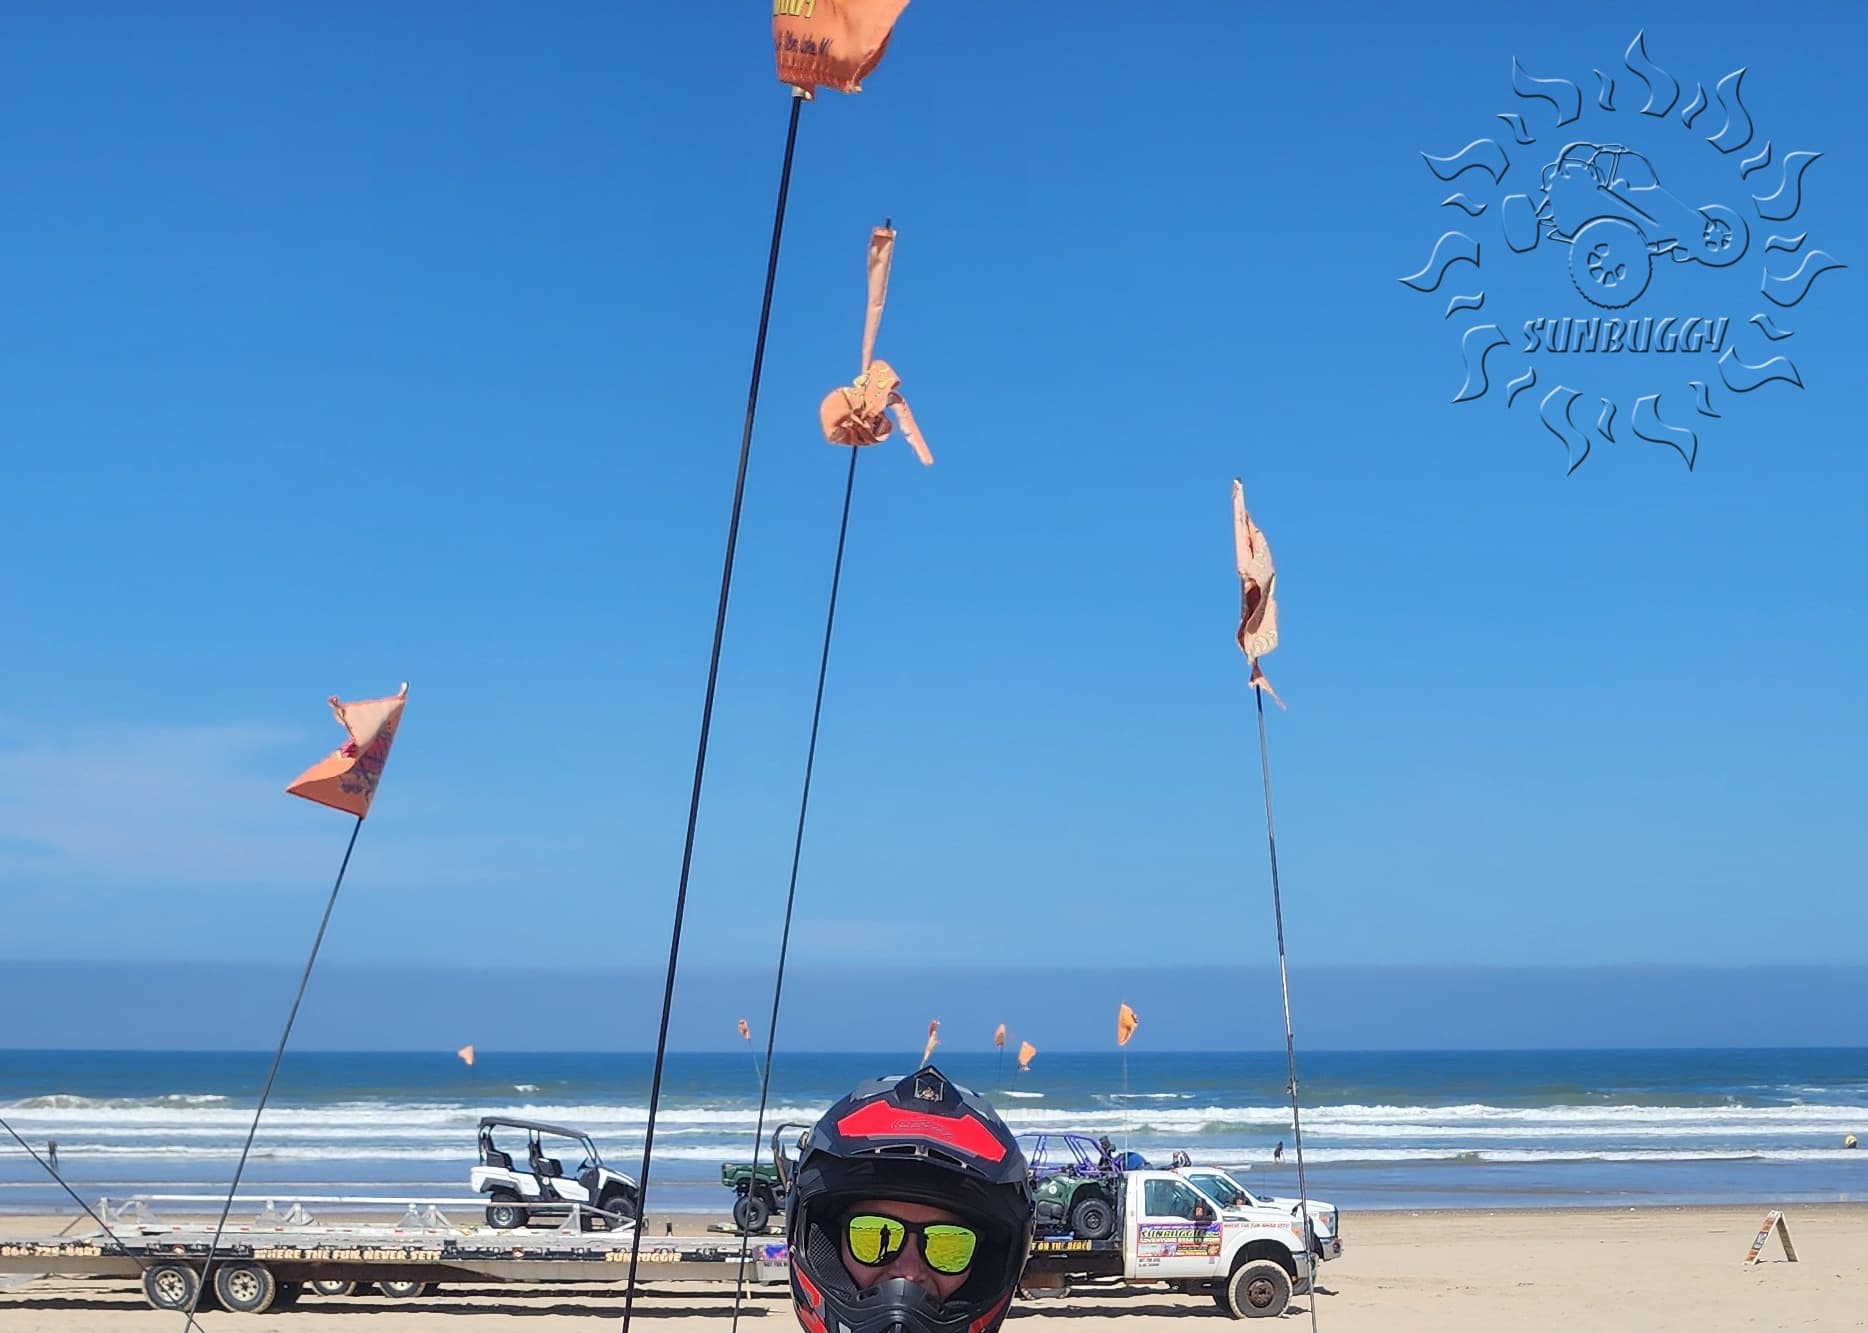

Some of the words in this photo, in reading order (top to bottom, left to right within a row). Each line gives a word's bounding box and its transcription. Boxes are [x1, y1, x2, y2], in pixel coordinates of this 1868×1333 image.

[253, 1249, 301, 1260] WHERE
[305, 1249, 330, 1260] THE
[332, 1249, 361, 1260] FUN
[363, 1249, 407, 1260] NEVER
[410, 1250, 442, 1260] SETS
